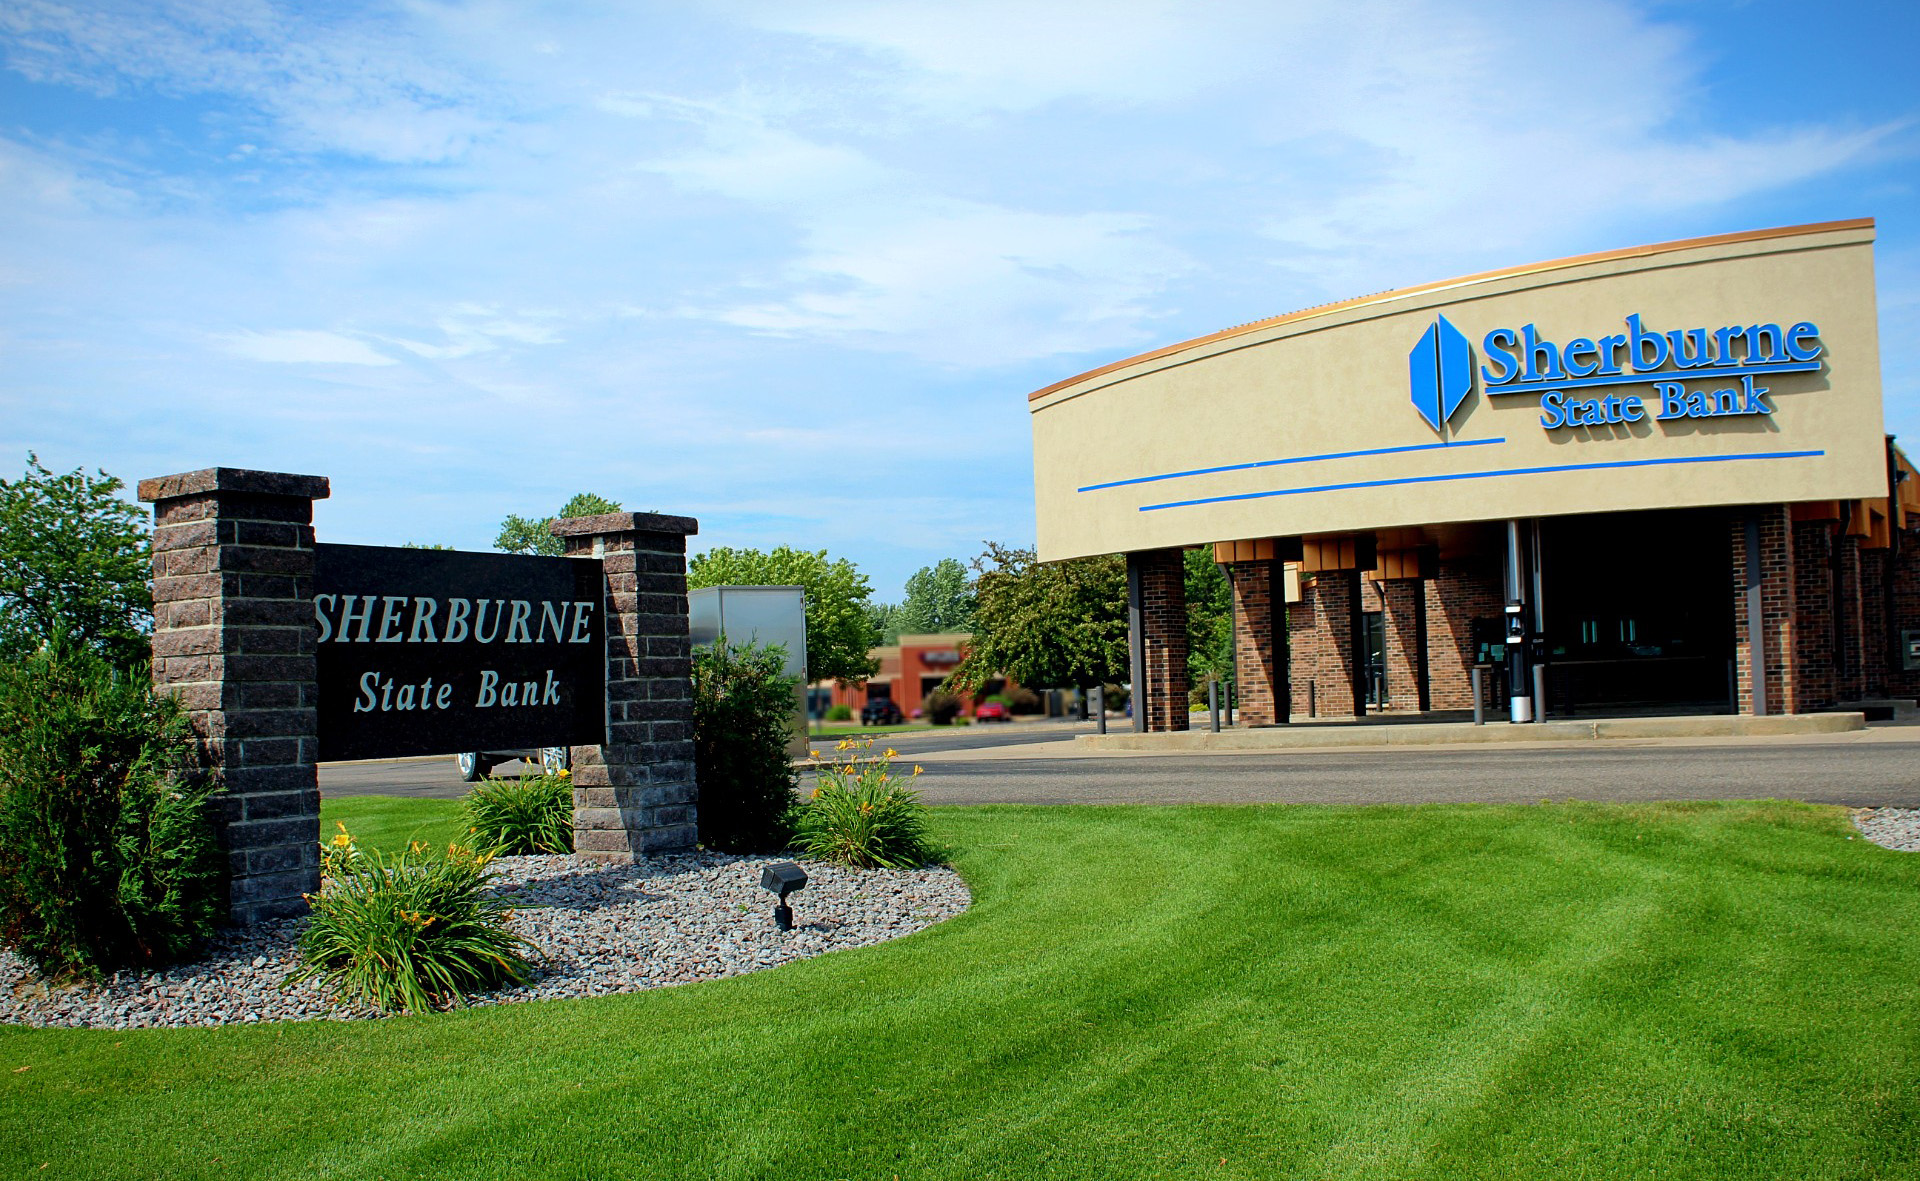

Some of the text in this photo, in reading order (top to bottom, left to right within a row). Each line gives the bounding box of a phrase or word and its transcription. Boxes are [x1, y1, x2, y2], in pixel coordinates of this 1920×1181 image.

[1481, 313, 1822, 385] Sherburne
[1540, 375, 1771, 429] State Bank
[313, 593, 594, 643] SHERBURNE
[354, 669, 561, 712] State Bank
